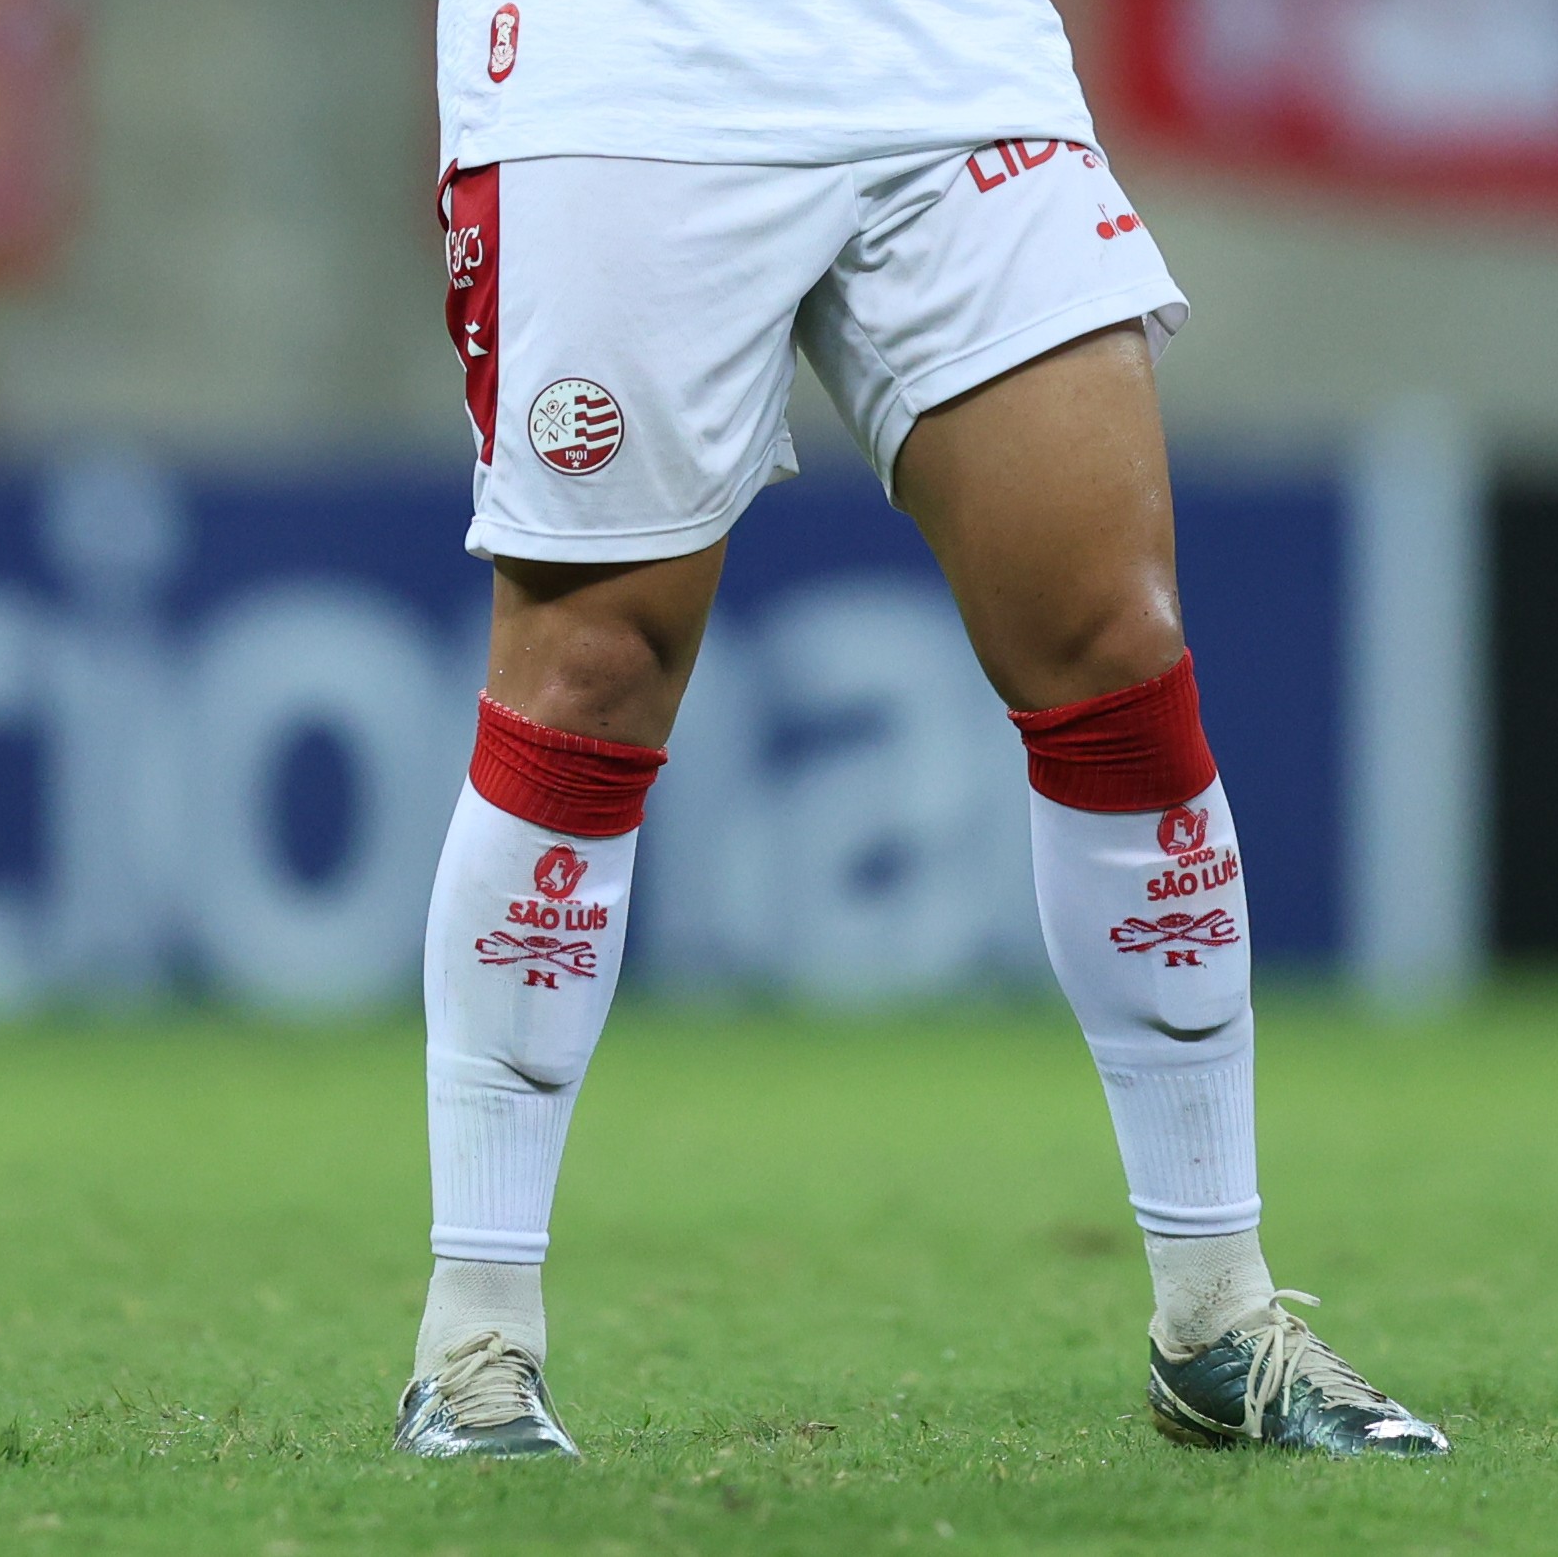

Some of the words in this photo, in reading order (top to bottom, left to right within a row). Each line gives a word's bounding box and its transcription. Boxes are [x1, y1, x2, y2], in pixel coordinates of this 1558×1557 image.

[966, 139, 1086, 193] LID
[547, 429, 559, 444] N
[565, 450, 588, 461] 1901
[1178, 846, 1216, 868] OVOS
[1147, 870, 1199, 902] SÃO
[505, 900, 560, 931] SÃO
[565, 902, 608, 932] LUÍS
